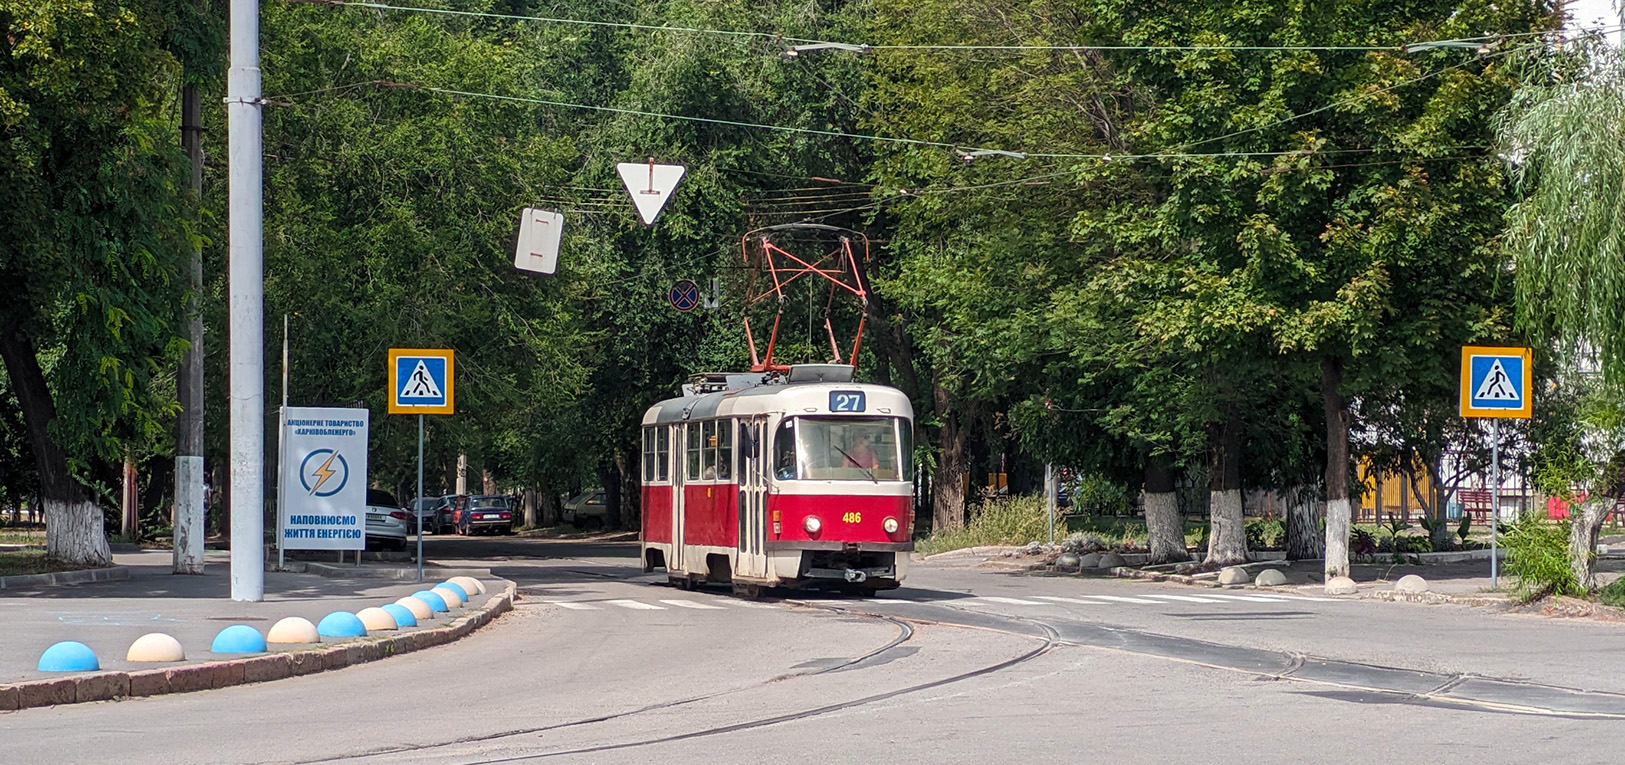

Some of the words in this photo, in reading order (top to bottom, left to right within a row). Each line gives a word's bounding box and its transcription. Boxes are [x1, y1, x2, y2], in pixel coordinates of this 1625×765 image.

[837, 394, 860, 411] 27
[290, 515, 356, 525] НАПОВНЮЄМО
[842, 512, 861, 523] 486
[284, 528, 315, 538] ЖИТТЯ
[317, 529, 361, 538] ЕНЕРГІЄЮ
